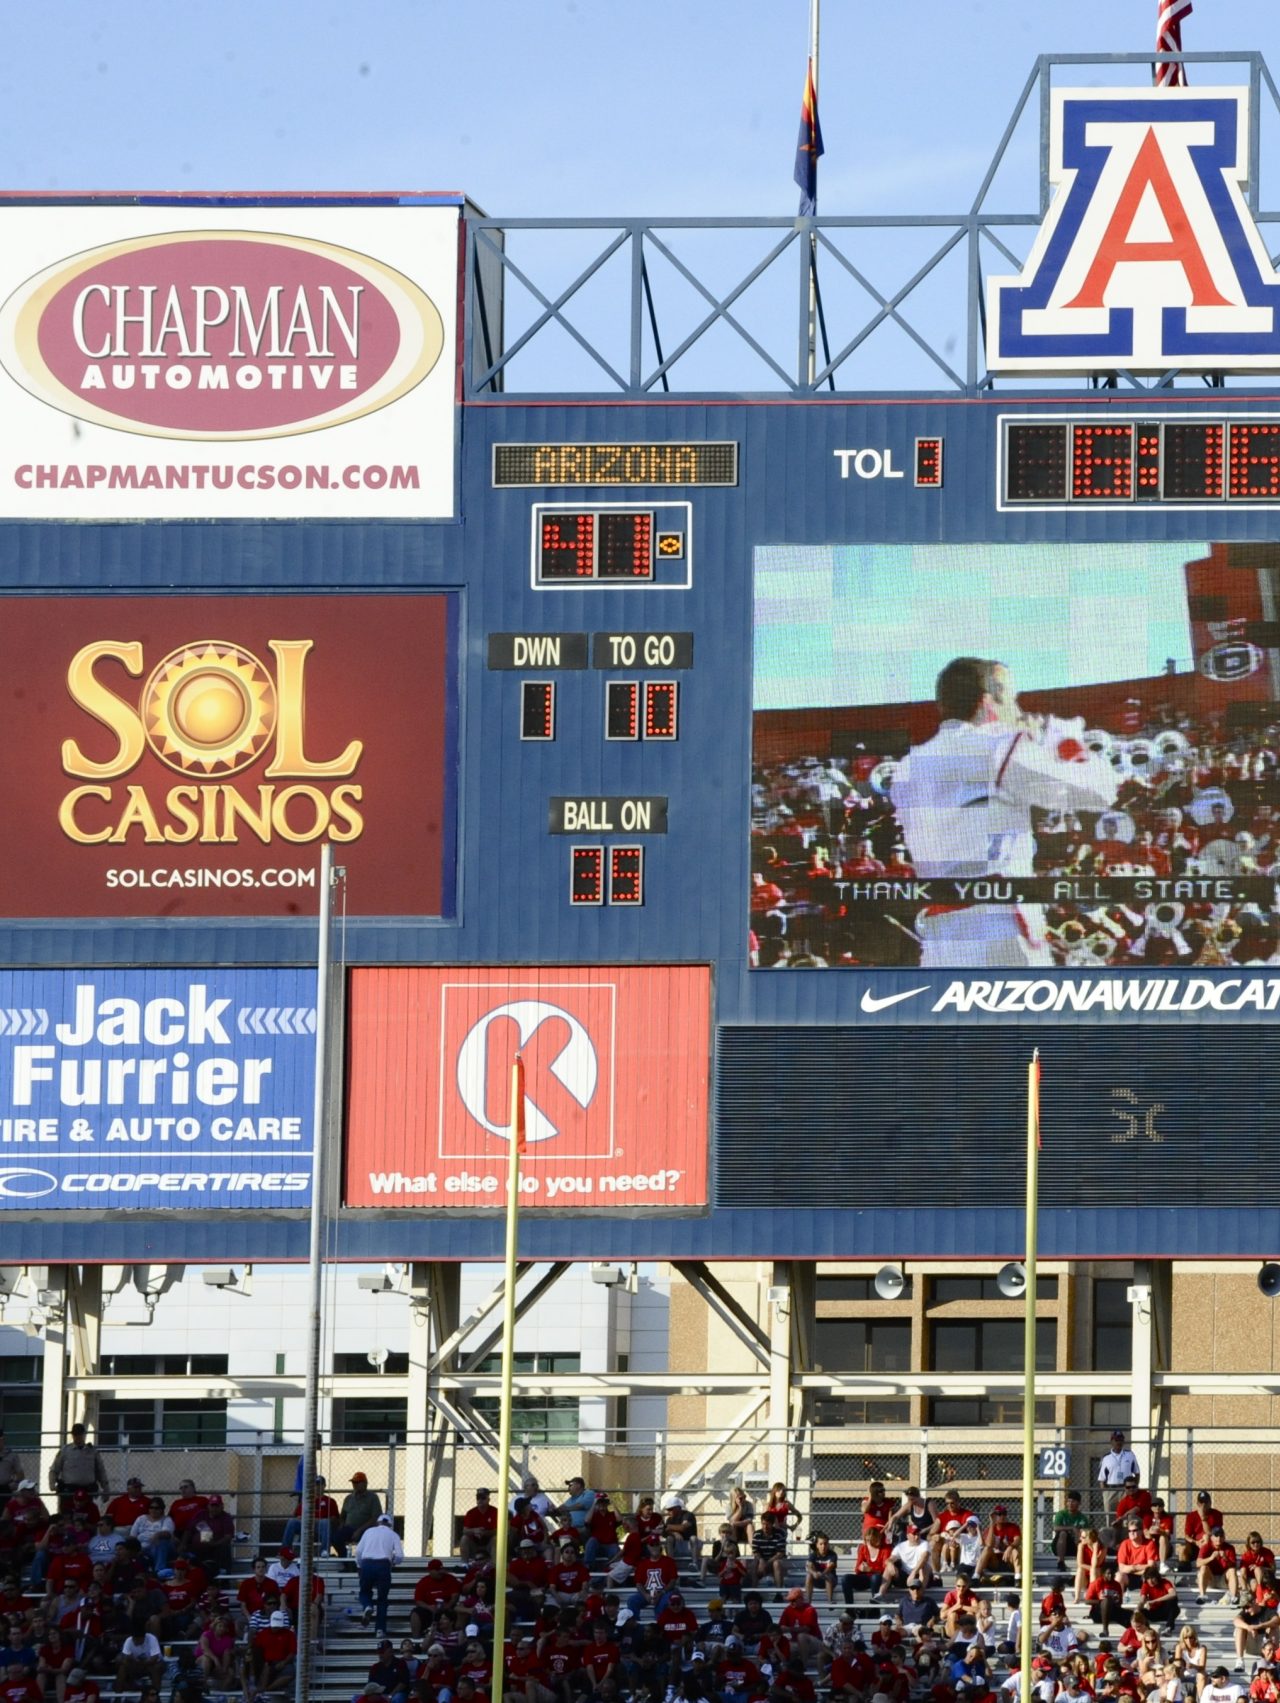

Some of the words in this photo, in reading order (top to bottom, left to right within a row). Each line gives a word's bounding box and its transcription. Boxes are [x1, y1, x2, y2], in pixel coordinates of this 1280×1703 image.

[72, 284, 365, 359] CHAPMAN
[80, 364, 358, 390] AUTOMOTIVE
[14, 464, 421, 490] CHAPMANTUCSON.COM
[535, 446, 697, 483] ARIZONA
[833, 449, 904, 479] TOL
[917, 441, 940, 484] 3
[542, 514, 650, 576] 41
[513, 636, 560, 666] DWN
[609, 636, 636, 665] TO
[644, 635, 675, 665] GO
[61, 638, 364, 779] SOL
[629, 684, 675, 736] 10
[59, 785, 365, 845] CASINOS
[563, 801, 613, 831] BALL
[620, 800, 651, 831] ON
[106, 867, 315, 888] SOLCASINOS.COM
[573, 850, 641, 900] 35
[832, 882, 932, 900] THANK
[954, 881, 1024, 902] YOU,
[1053, 881, 1111, 899] ALL
[1134, 879, 1247, 899] STATE.
[55, 984, 233, 1046] Jack
[12, 1045, 273, 1106] Furrier
[0, 1118, 59, 1142] IRE
[69, 1118, 95, 1142] &
[105, 1117, 201, 1141] AUTO
[210, 1117, 302, 1141] CARE
[60, 1172, 311, 1192] COOPERTIRES
[369, 1172, 437, 1193] What
[444, 1172, 499, 1193] else
[545, 1176, 593, 1197] you
[599, 1169, 681, 1192] need?
[1043, 1449, 1067, 1475] 28
